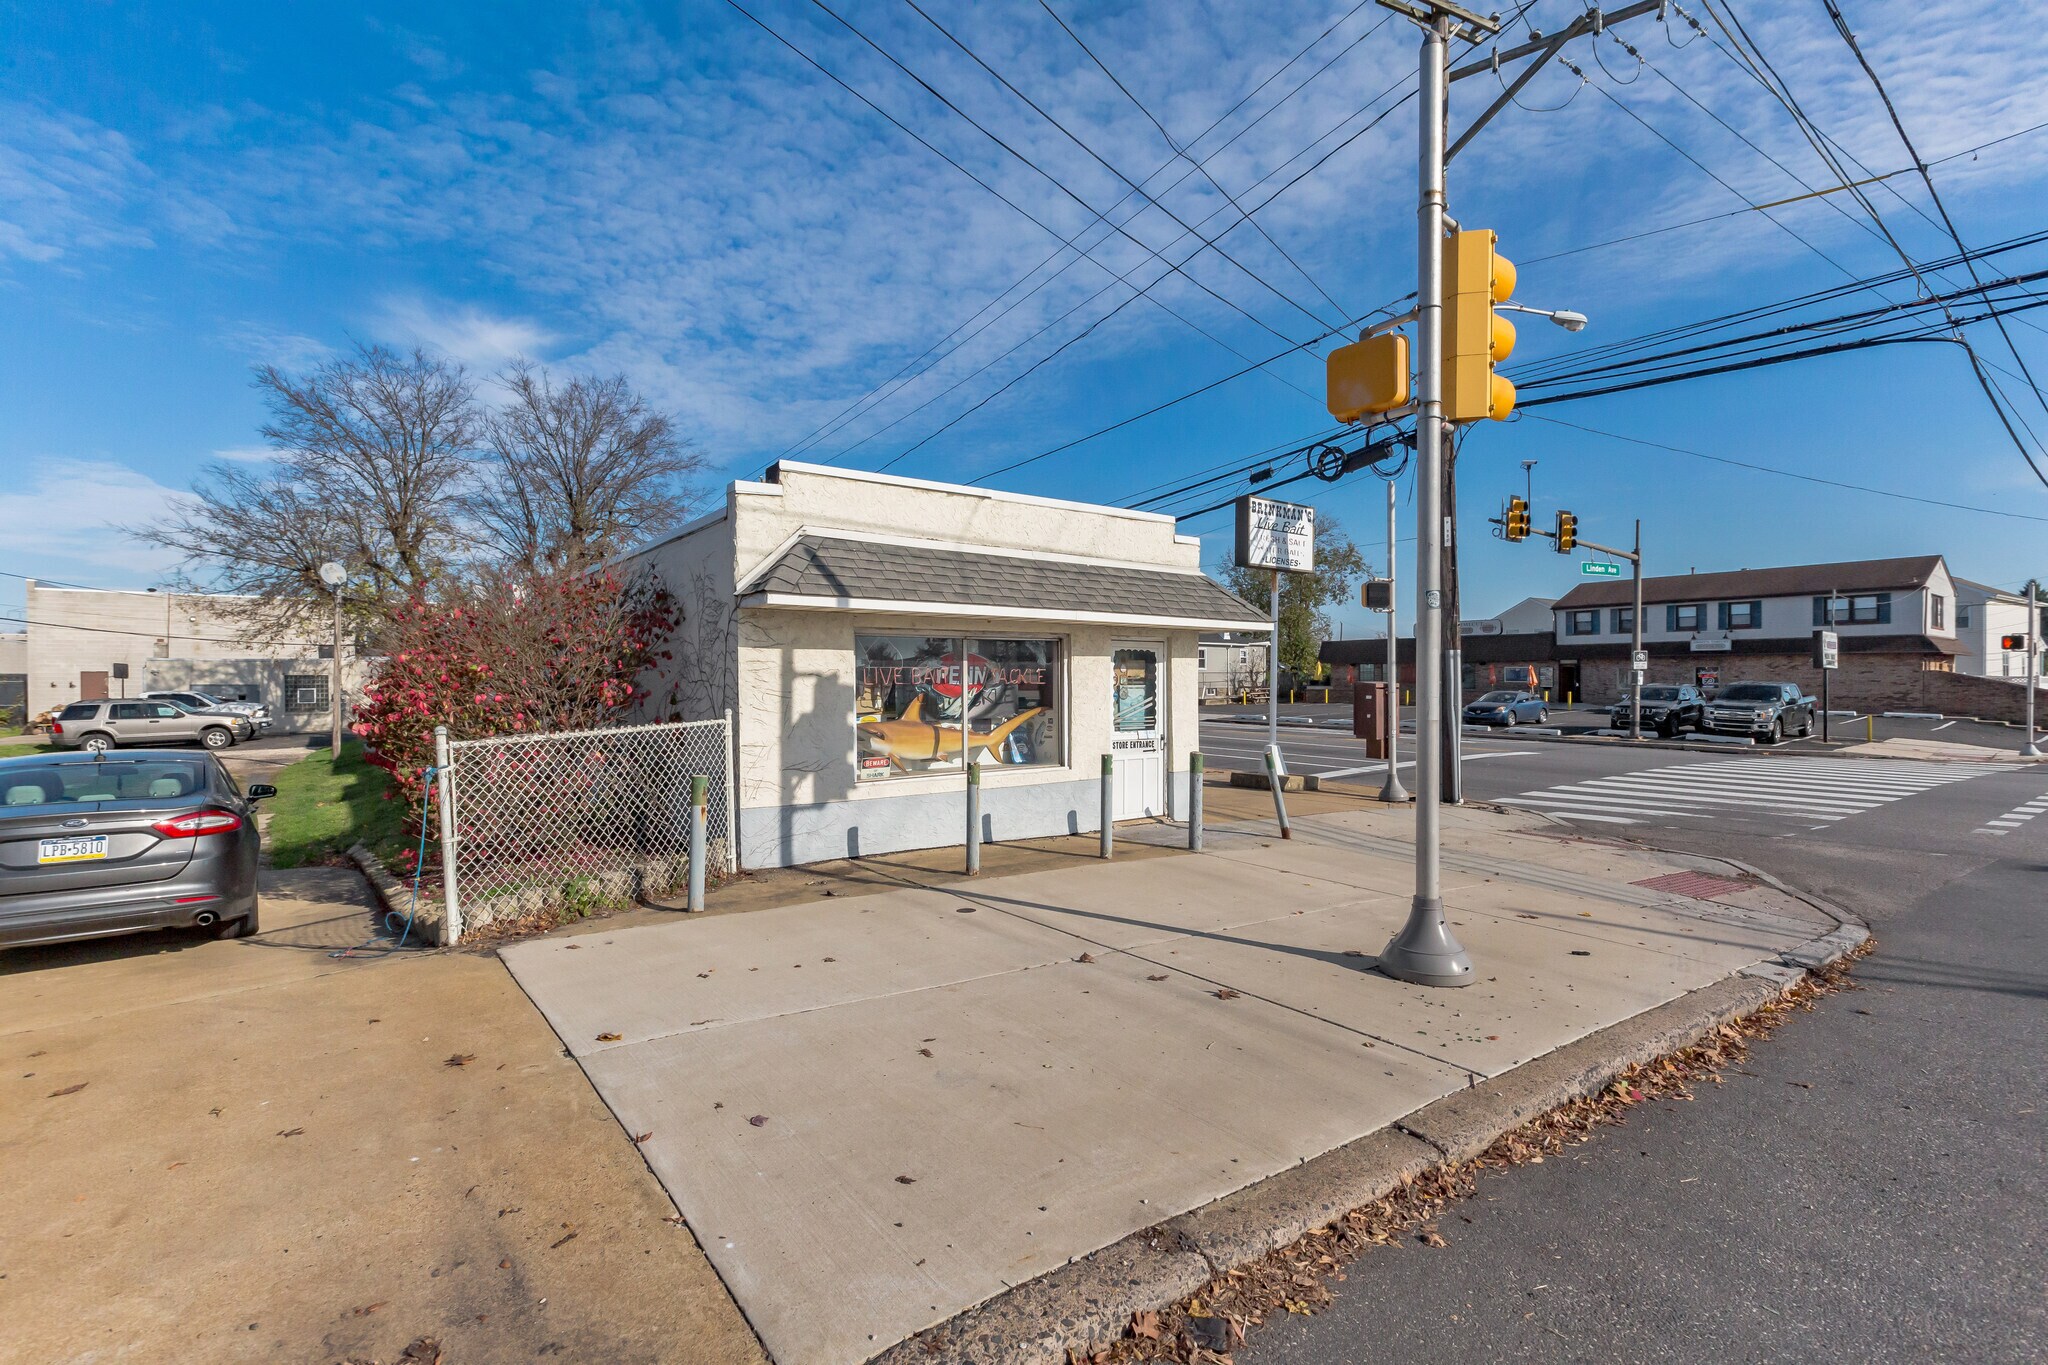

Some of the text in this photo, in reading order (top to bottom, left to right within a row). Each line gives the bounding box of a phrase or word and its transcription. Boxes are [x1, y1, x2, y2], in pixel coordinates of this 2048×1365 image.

[1251, 501, 1311, 522] BRINKMAN'S
[1257, 517, 1304, 535] Live Bait
[1265, 556, 1299, 566] LICENSES
[1586, 564, 1605, 572] Linden
[863, 667, 903, 685] LIVE
[1112, 741, 1129, 749] STORE
[865, 759, 887, 767] BEWARE
